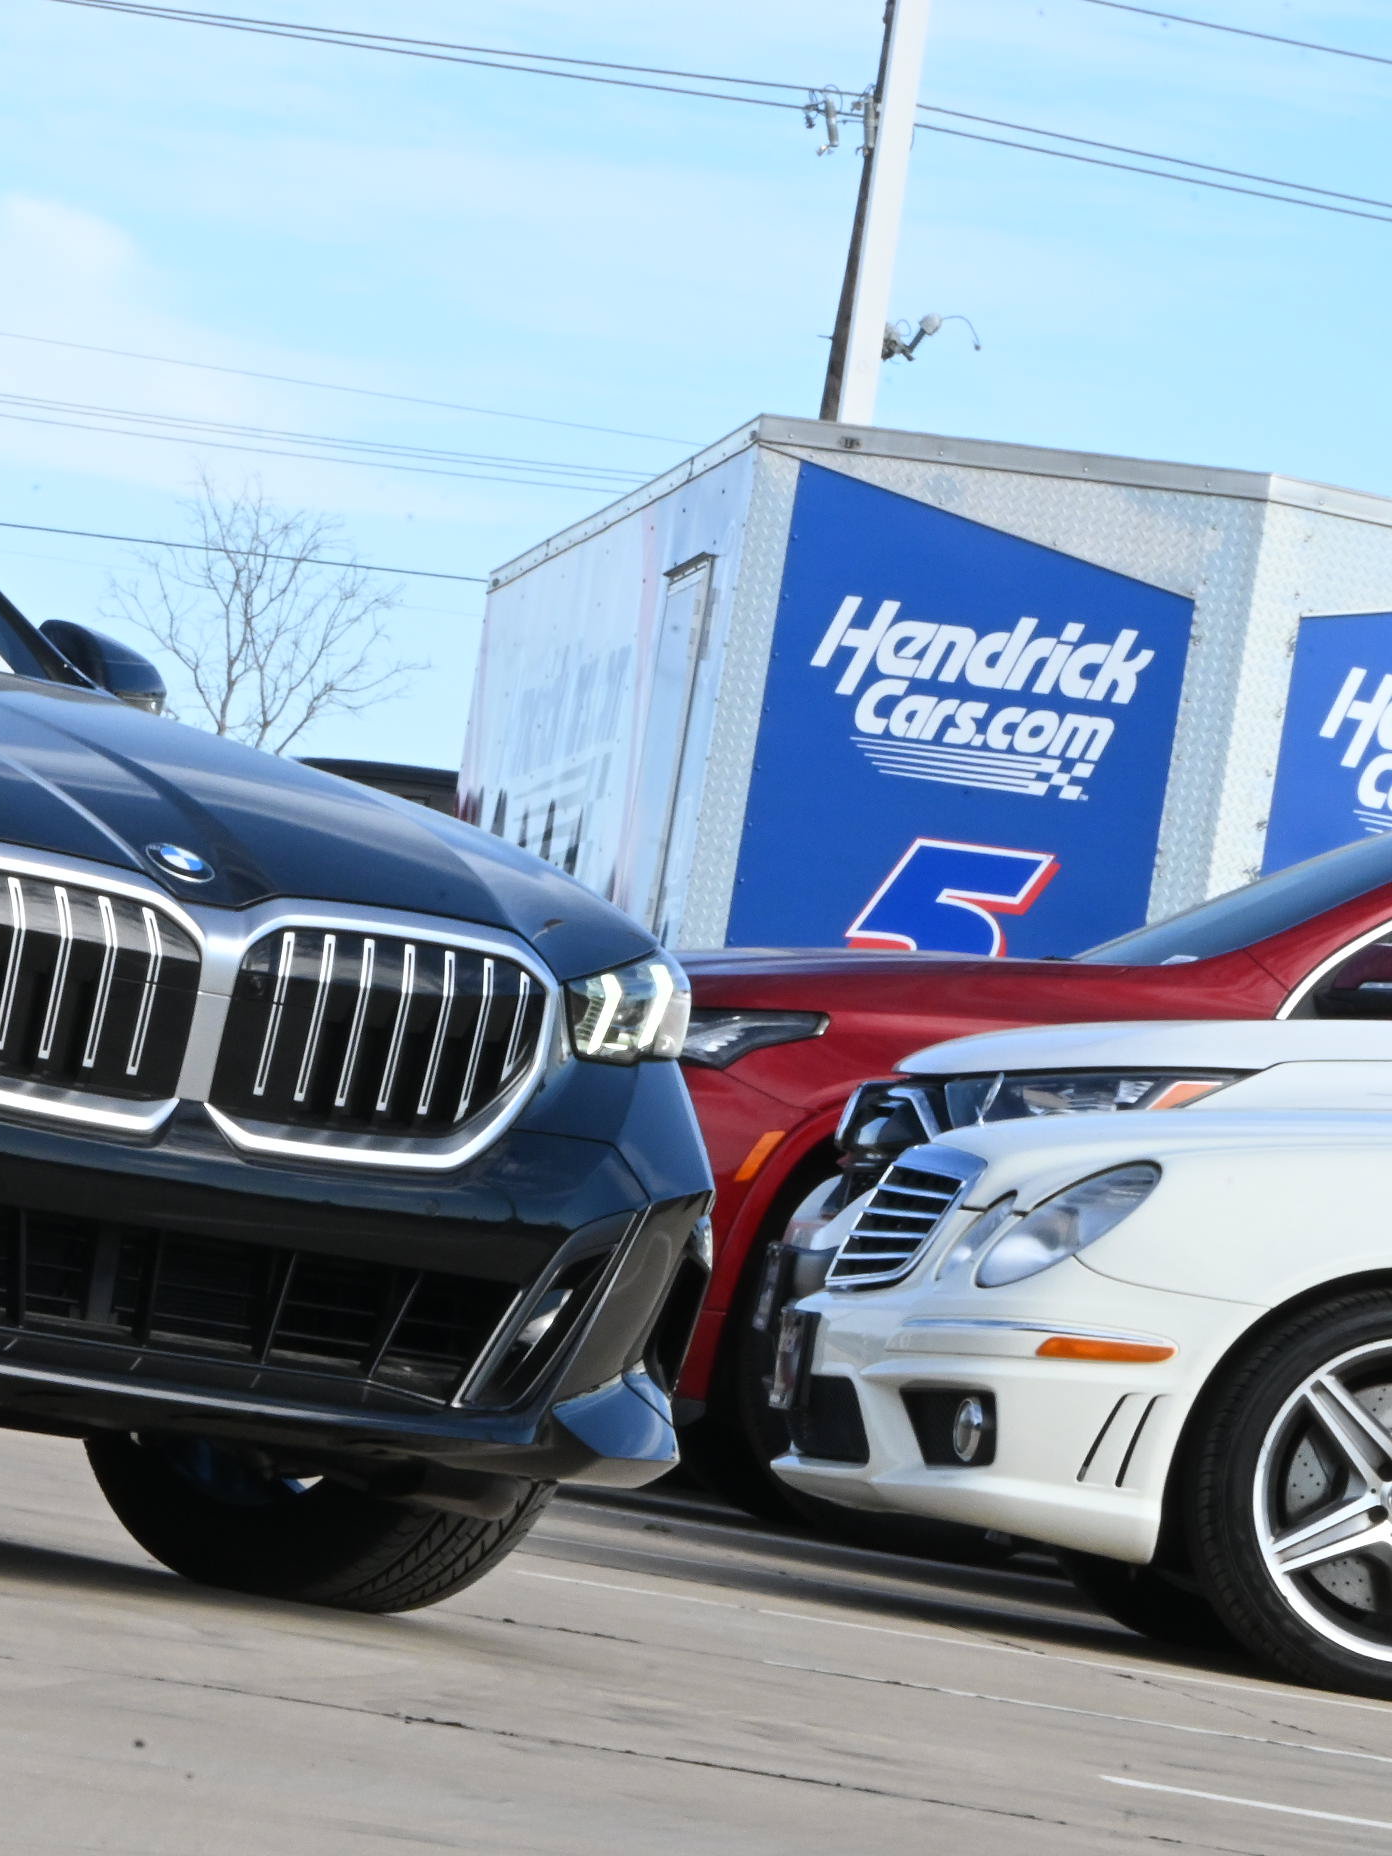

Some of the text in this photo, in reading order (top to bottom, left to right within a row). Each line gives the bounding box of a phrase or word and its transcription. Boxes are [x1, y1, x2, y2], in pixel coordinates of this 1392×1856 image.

[811, 596, 1155, 704] Hendrick
[855, 678, 1115, 761] Cars.com
[845, 838, 1061, 957] 5
